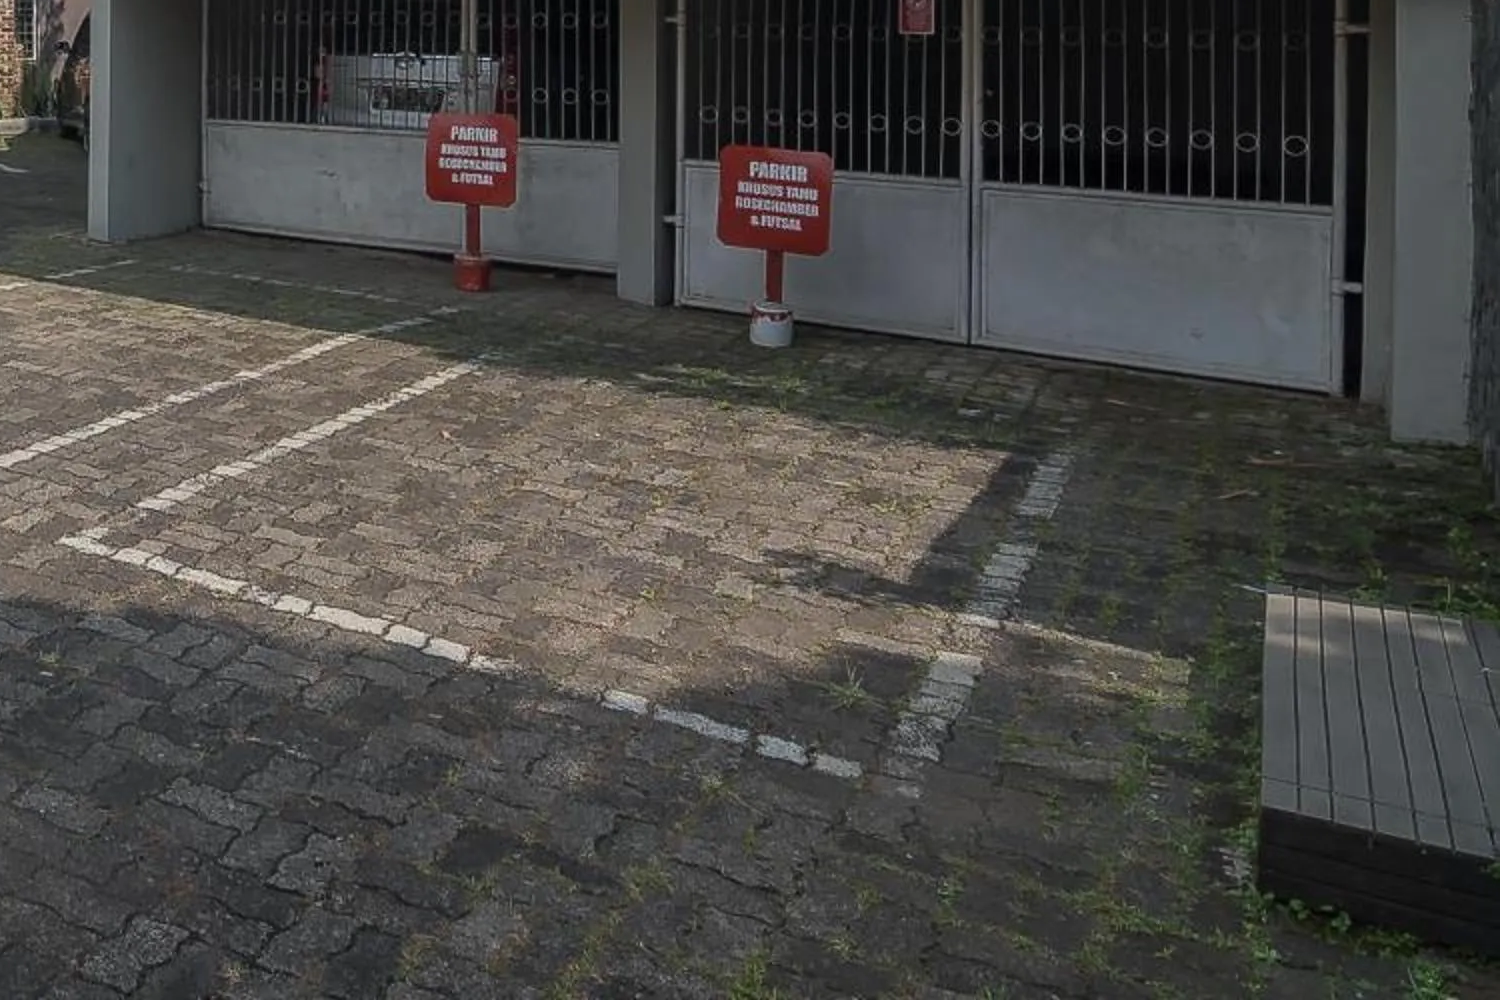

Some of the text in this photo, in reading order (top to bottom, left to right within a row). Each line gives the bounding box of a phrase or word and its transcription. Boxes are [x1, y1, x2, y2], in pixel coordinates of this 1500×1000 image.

[451, 125, 498, 142] PARKIR
[749, 161, 808, 182] PARKIR
[737, 181, 819, 201] KHUSUS TAMU
[761, 215, 802, 231] FUTSAL
